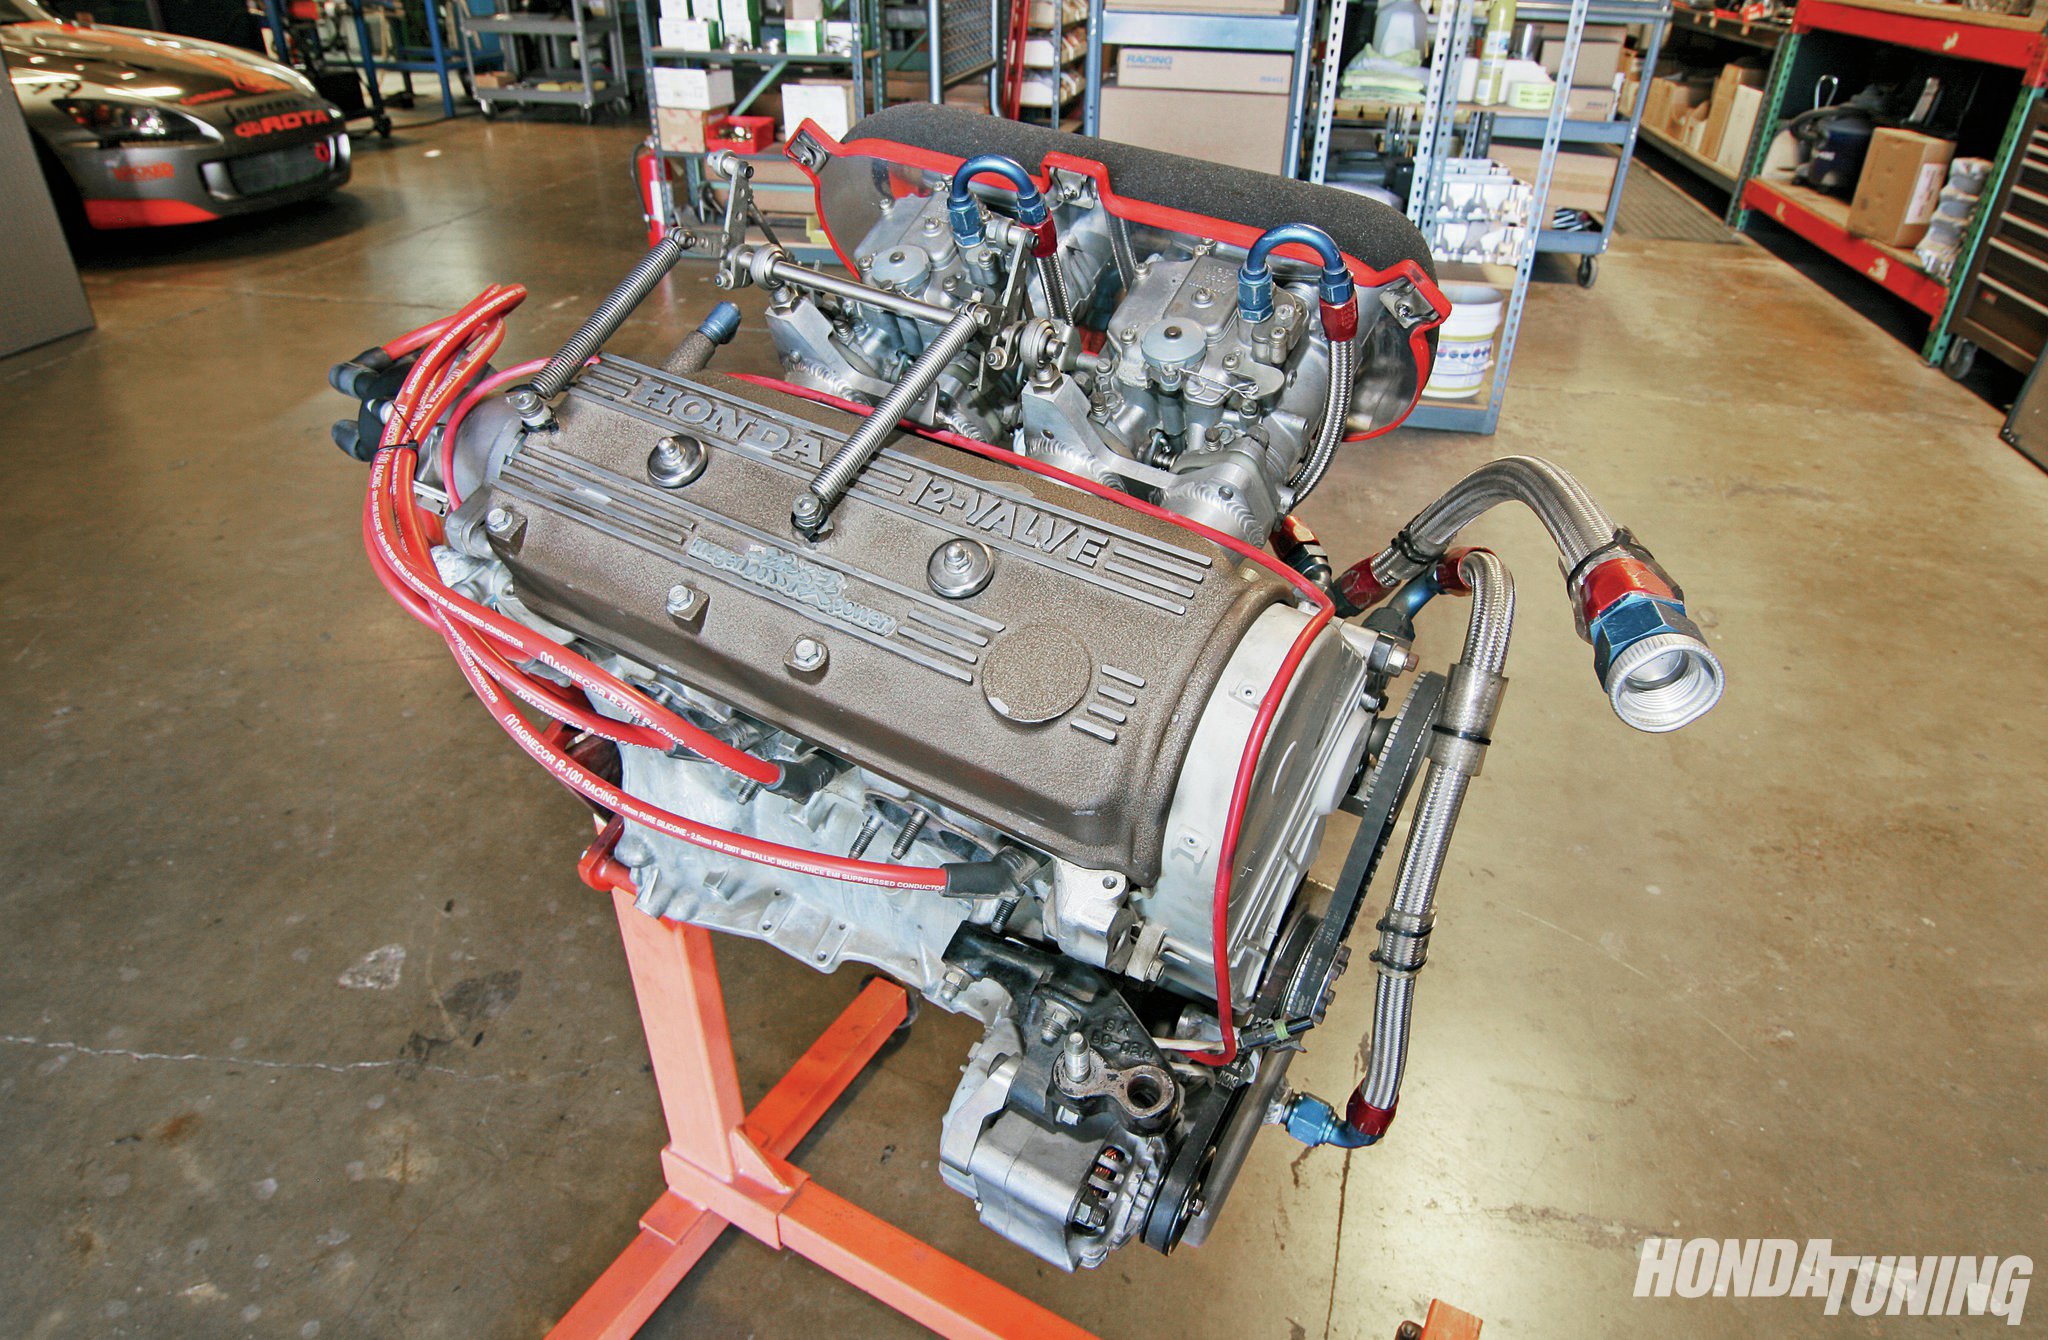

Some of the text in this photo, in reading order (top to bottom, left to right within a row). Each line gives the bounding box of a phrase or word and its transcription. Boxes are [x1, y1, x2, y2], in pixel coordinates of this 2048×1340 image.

[1126, 55, 1172, 65] RACING
[260, 109, 329, 135] ROTA
[406, 365, 426, 394] CONDUCTOR
[631, 379, 825, 470] HONDA
[908, 476, 1110, 568] 12-VALVE
[411, 576, 442, 601] INDUCTANCE
[447, 602, 486, 629] SUPPRESSED
[484, 622, 524, 650] CONDUCTOR
[471, 665, 499, 704] CONDUCTOR
[539, 651, 607, 699] MAGNECOR
[608, 693, 643, 720] R-100
[503, 713, 556, 765] MAGNECOR
[554, 758, 584, 785] R-100
[582, 778, 619, 807] RACING
[620, 803, 639, 818] 10mm
[638, 811, 657, 825] PURE
[656, 818, 688, 837] SILICONE
[740, 847, 776, 865] METALLIC
[776, 858, 825, 877] INDUCTANCE
[826, 870, 841, 880] EMI
[841, 872, 896, 888] SUPPRESSED
